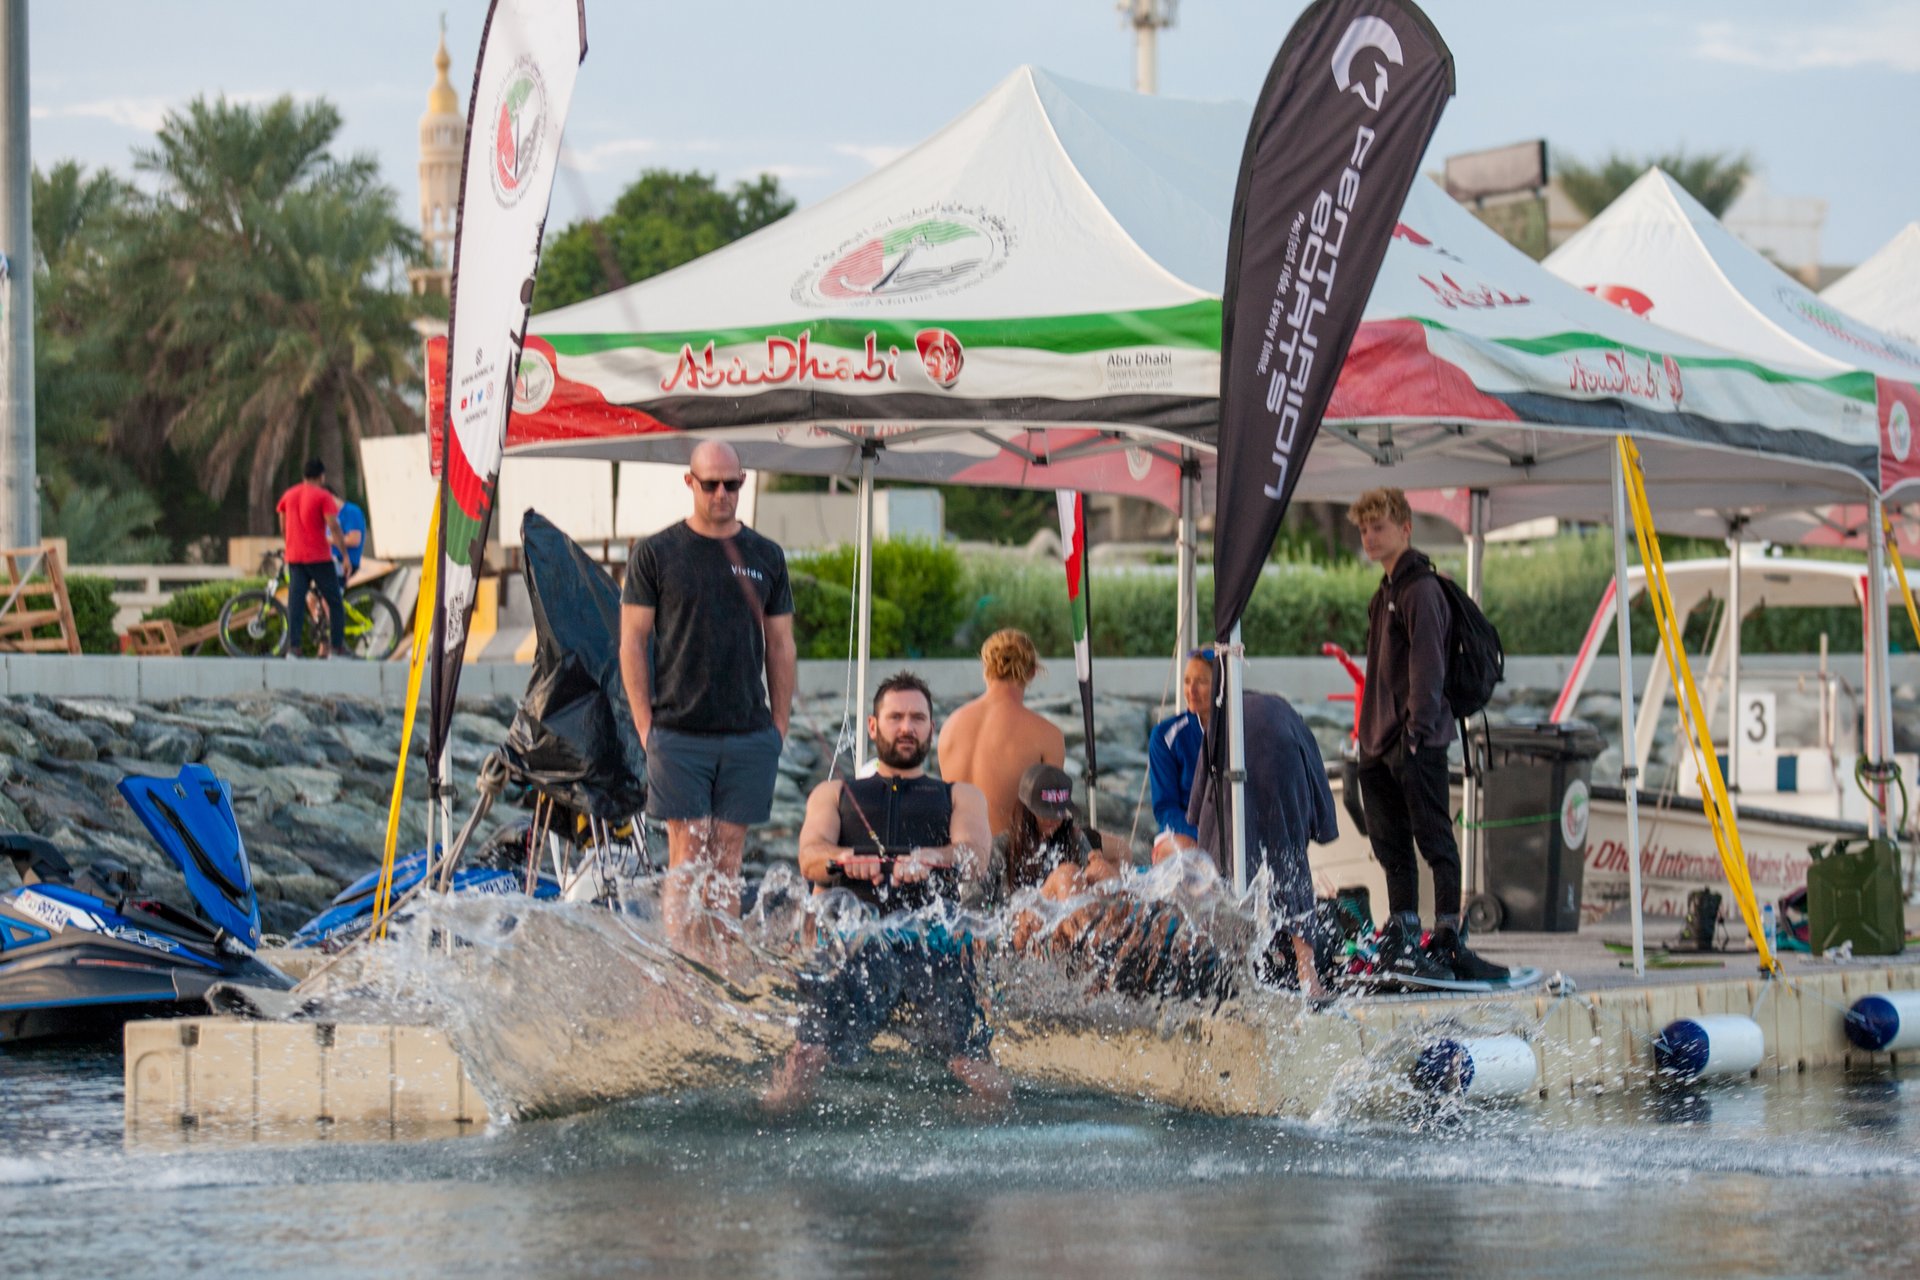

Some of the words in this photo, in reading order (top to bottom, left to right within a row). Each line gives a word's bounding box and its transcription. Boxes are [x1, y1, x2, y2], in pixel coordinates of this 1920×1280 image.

[1286, 211, 1305, 265] Perfect
[1266, 189, 1333, 415] BOATS
[1276, 264, 1292, 297] ride.
[1265, 298, 1284, 341] Every
[1107, 353, 1132, 367] Abu
[1136, 350, 1172, 366] Dhabi
[1256, 340, 1274, 377] time.
[1747, 700, 1768, 743] 3
